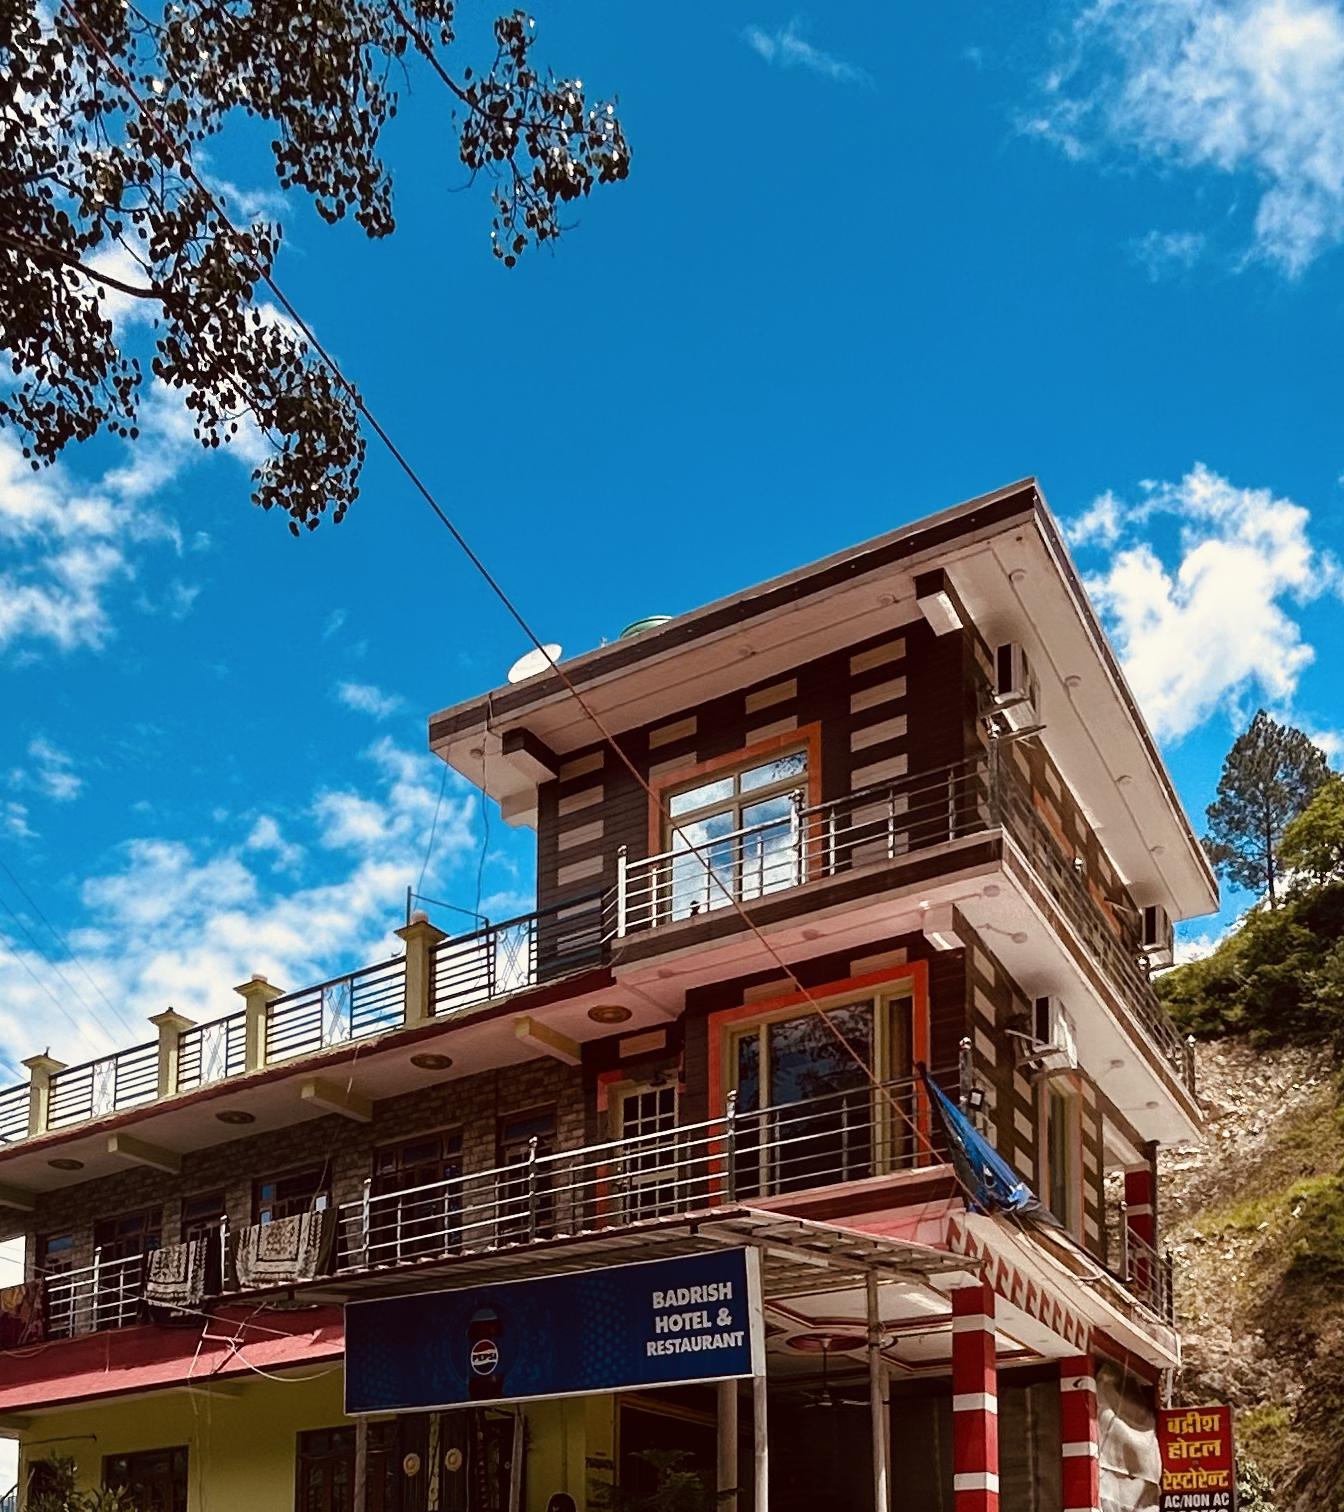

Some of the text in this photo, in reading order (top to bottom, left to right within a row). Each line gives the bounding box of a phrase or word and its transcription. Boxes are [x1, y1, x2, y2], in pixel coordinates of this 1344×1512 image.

[653, 1282, 733, 1309] BADRISH
[655, 1307, 732, 1334] HOTEL &
[646, 1331, 745, 1356] RESTAURANT
[1166, 1437, 1222, 1459] होटल
[1164, 1492, 1230, 1509] AC/NON AC
